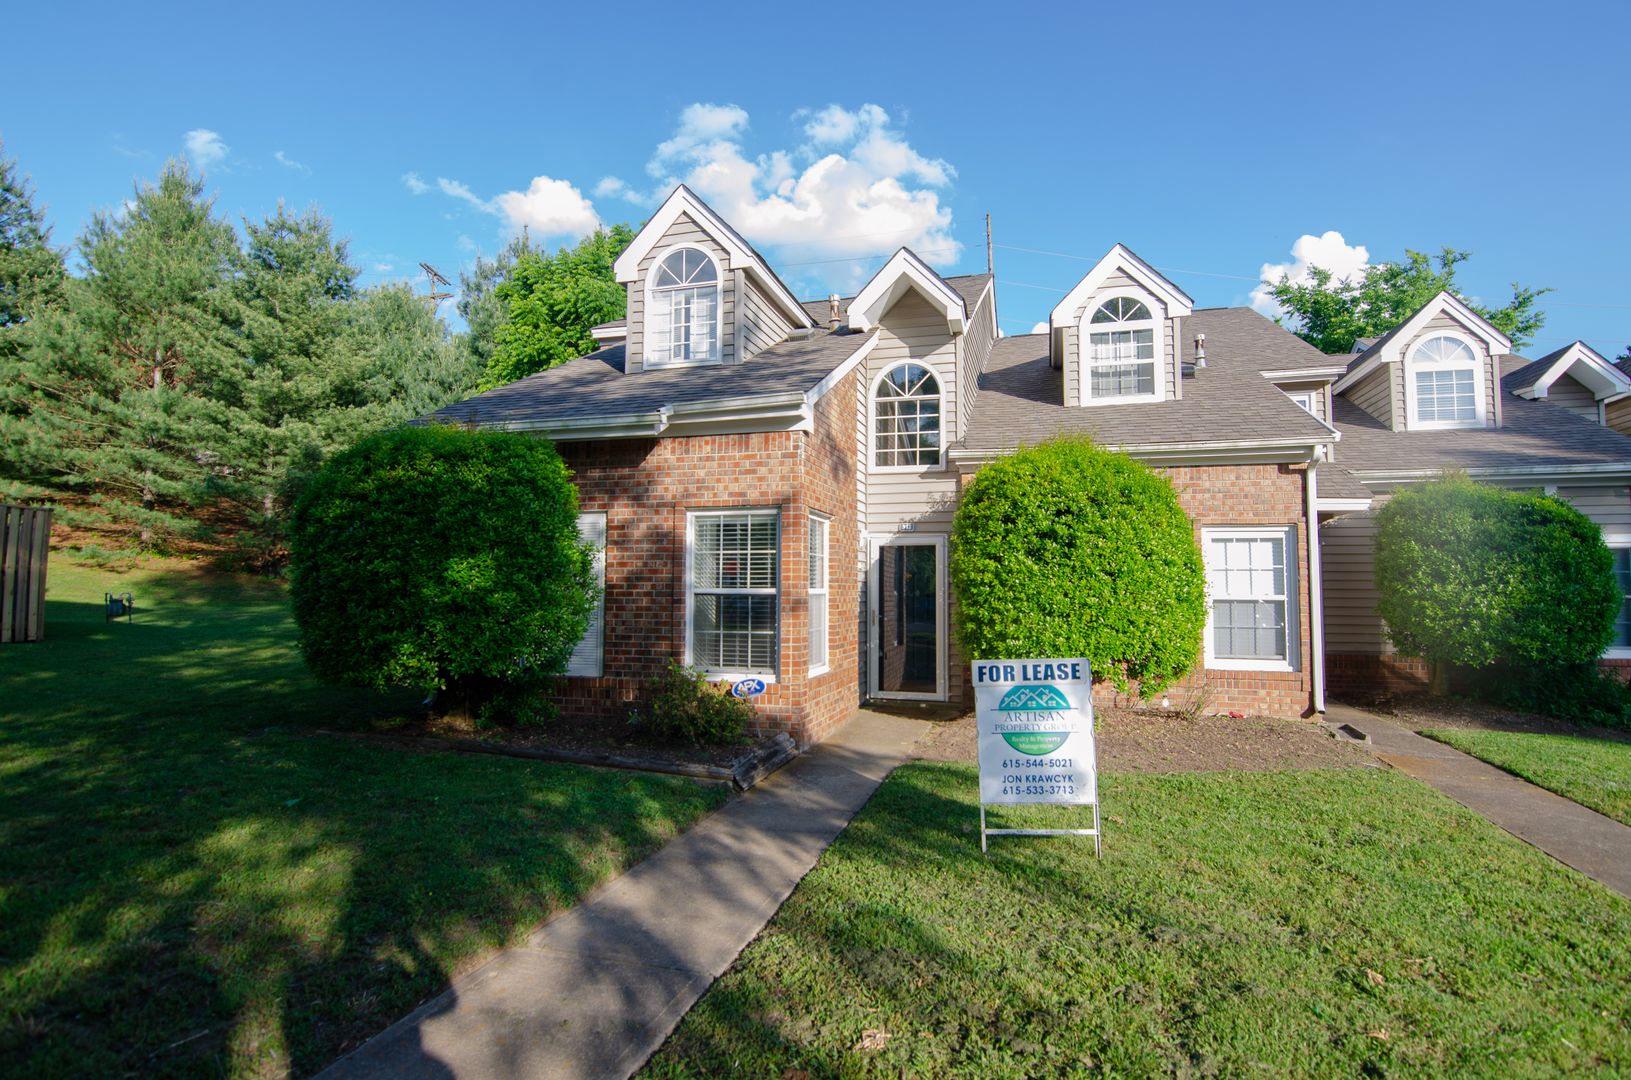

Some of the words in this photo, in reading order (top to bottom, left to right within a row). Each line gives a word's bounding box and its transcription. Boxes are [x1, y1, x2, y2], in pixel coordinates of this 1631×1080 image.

[978, 665, 1015, 682] FOR
[1022, 663, 1081, 681] LEASE
[1004, 711, 1065, 722] ARTISAN
[995, 723, 1041, 731] PROPERTY
[1002, 759, 1073, 769] 615-544-5021
[1001, 775, 1022, 783] JON
[1025, 774, 1074, 783] KRAWCYK
[1002, 786, 1074, 795] 615-533-3713
